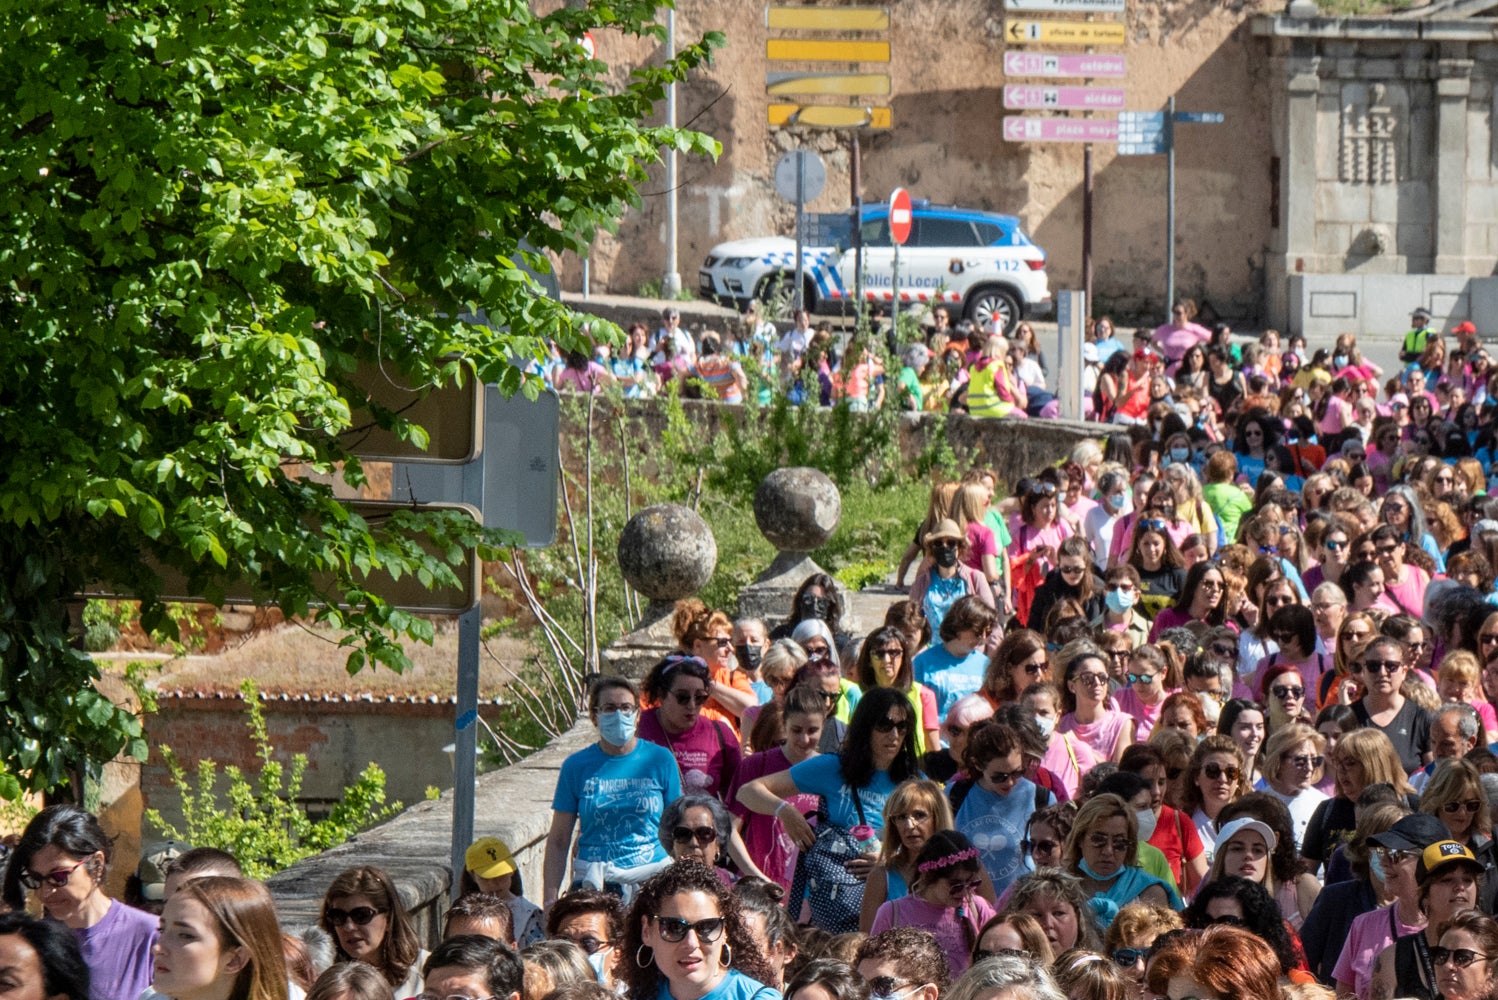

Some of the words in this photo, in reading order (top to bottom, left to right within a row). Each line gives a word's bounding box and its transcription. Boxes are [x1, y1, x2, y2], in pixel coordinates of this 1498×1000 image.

[1079, 60, 1123, 72] catedral
[1056, 124, 1085, 136] plaza
[1089, 125, 1118, 138] mayo
[994, 260, 1020, 272] 112
[908, 275, 944, 288] Local
